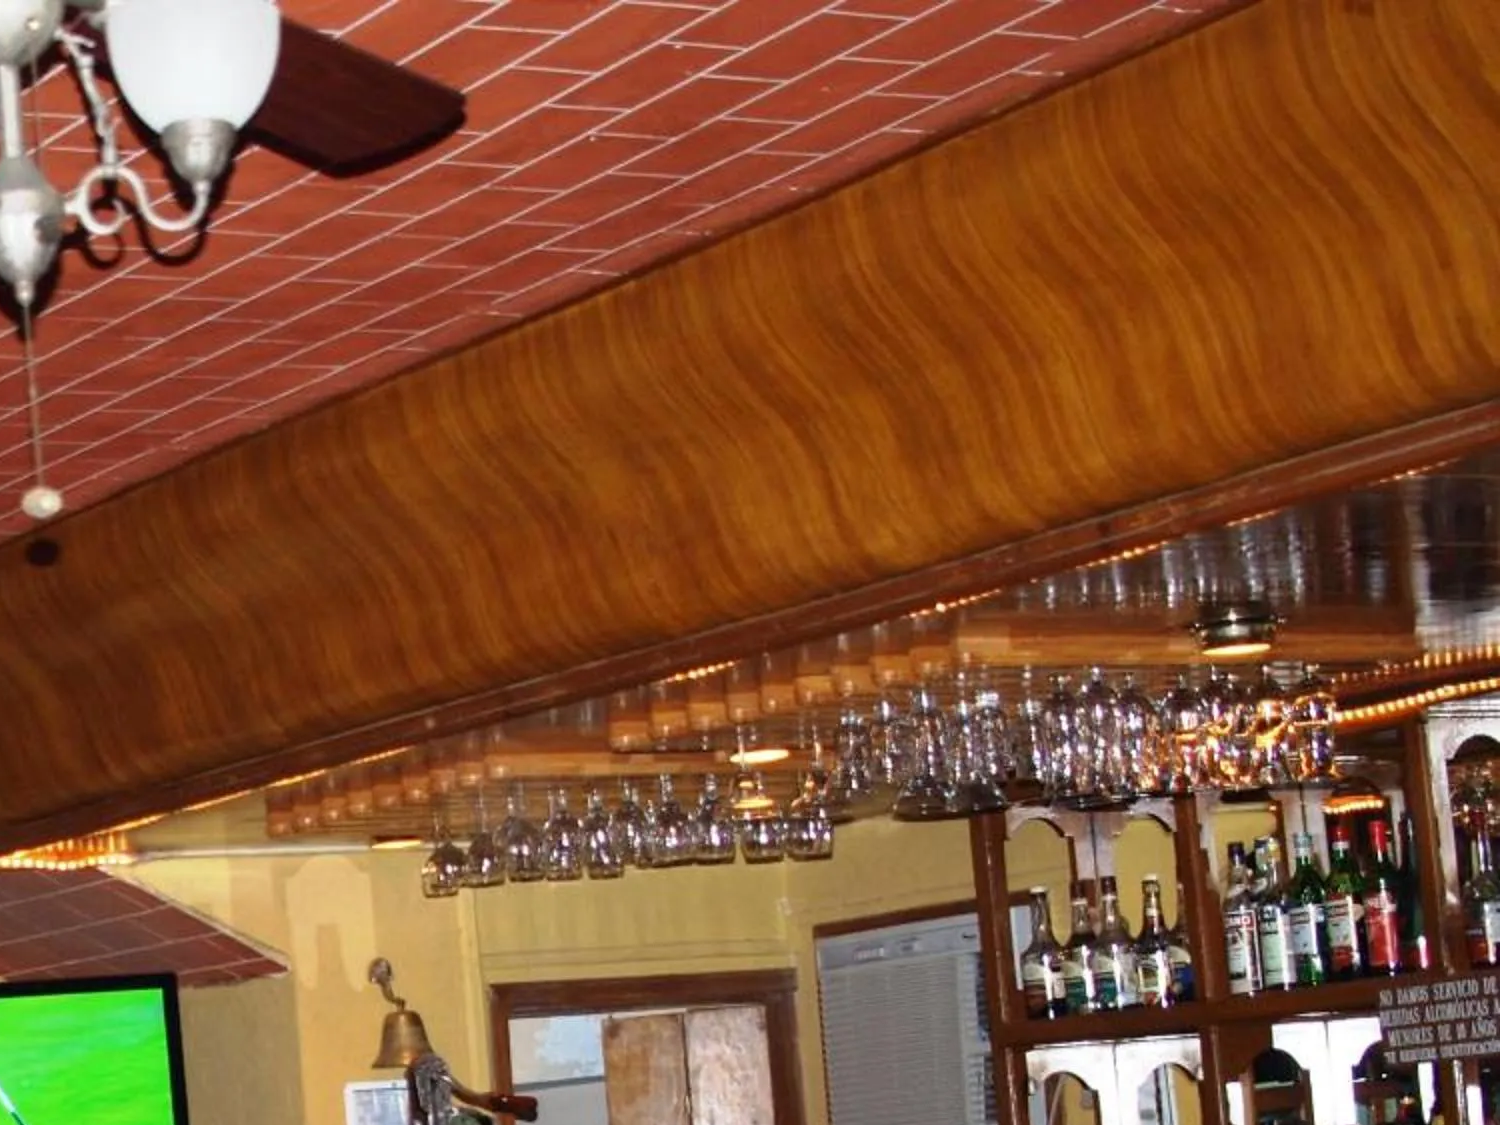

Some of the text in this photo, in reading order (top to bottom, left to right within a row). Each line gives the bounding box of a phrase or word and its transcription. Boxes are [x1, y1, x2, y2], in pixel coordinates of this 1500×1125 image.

[1380, 988, 1393, 1006] NO
[1430, 979, 1479, 1000] SERVICIO
[1483, 976, 1499, 995] DE
